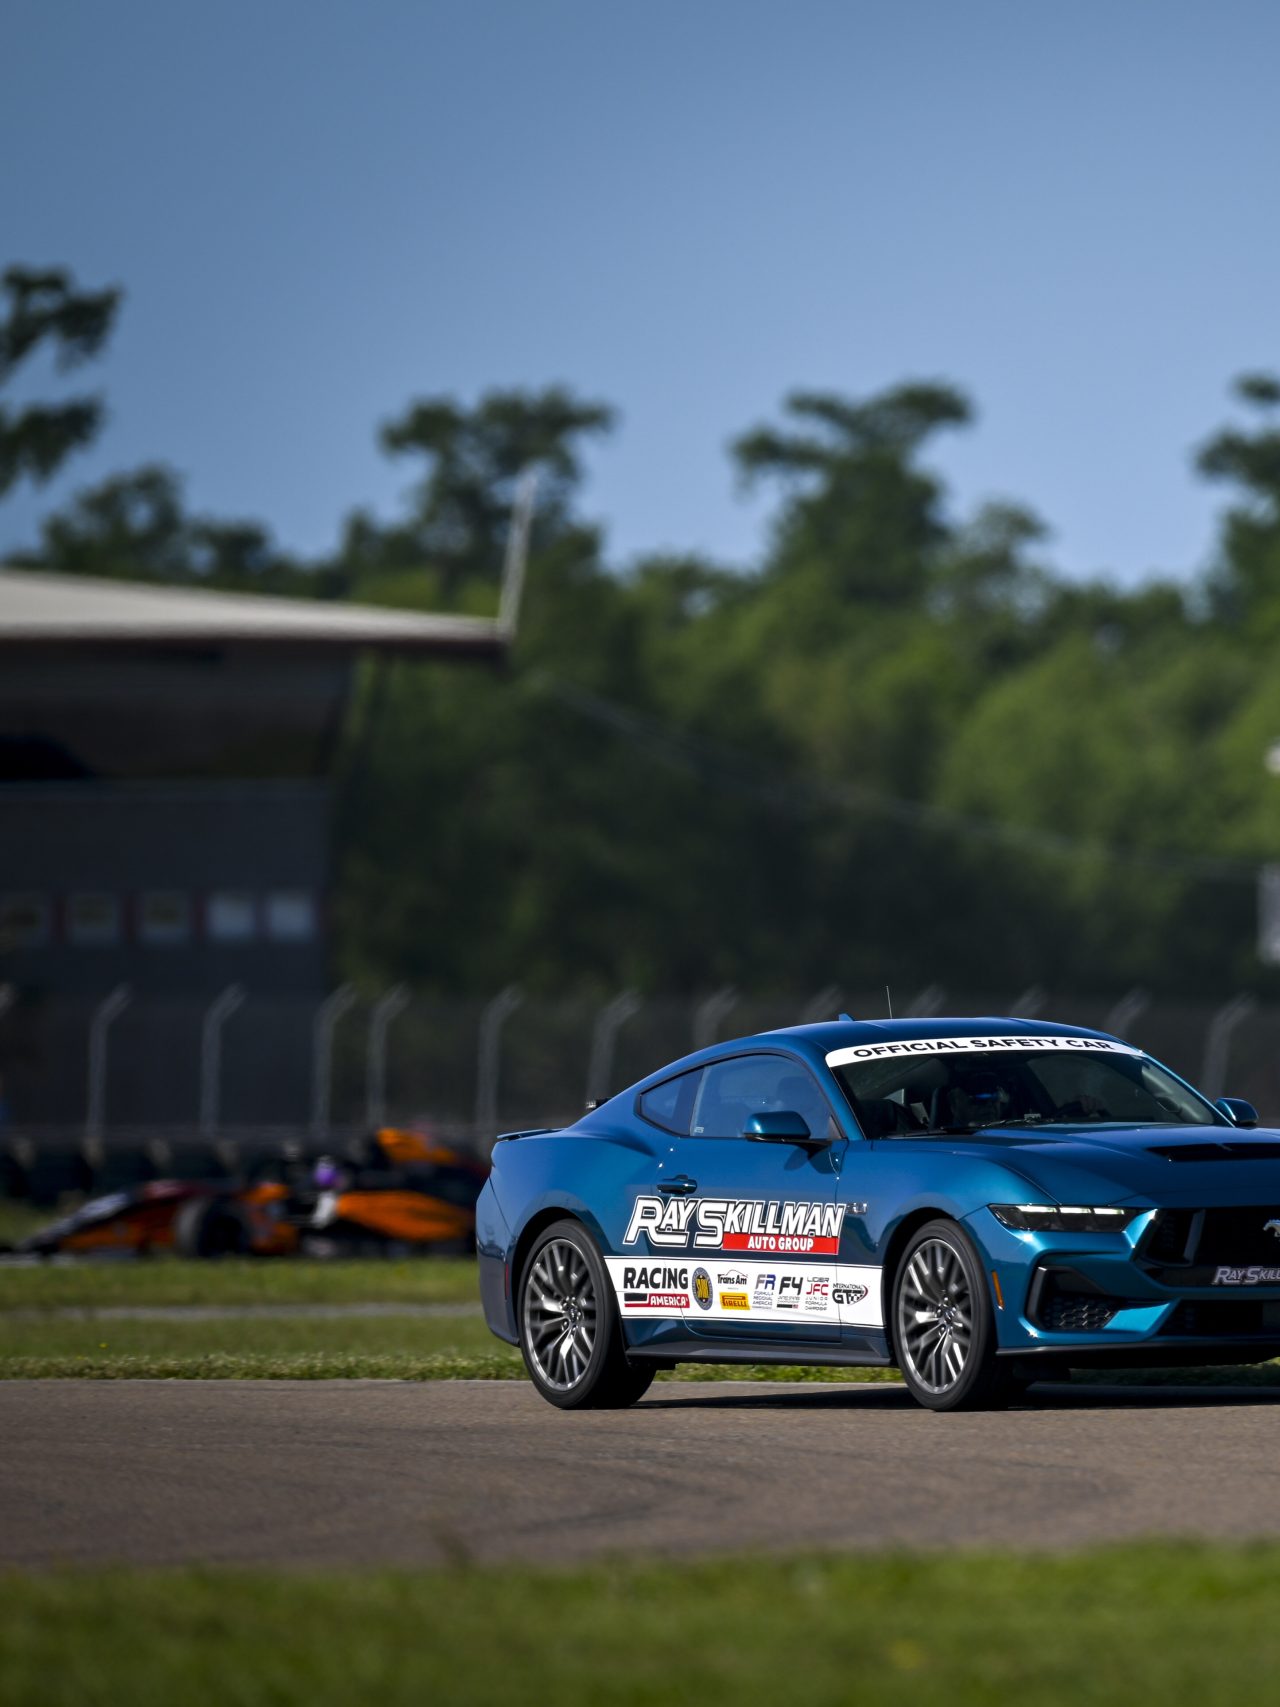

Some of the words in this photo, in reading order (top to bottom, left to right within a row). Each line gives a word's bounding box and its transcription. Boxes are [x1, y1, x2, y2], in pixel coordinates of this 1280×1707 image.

[853, 1040, 968, 1058] OFFICIAL
[970, 1038, 1059, 1049] SAFETY
[1065, 1039, 1114, 1051] CAR
[623, 1196, 697, 1248] RAY
[693, 1198, 847, 1250] SKILLMAN
[747, 1235, 777, 1249] AUTO
[778, 1236, 814, 1252] GROUP
[623, 1267, 689, 1290] RACING
[717, 1274, 735, 1285] Trans
[735, 1274, 747, 1285] Am
[755, 1274, 776, 1290] FR
[779, 1276, 804, 1295] F4
[806, 1283, 829, 1296] JFC
[832, 1288, 864, 1304] GT
[650, 1296, 686, 1307] AMERICA
